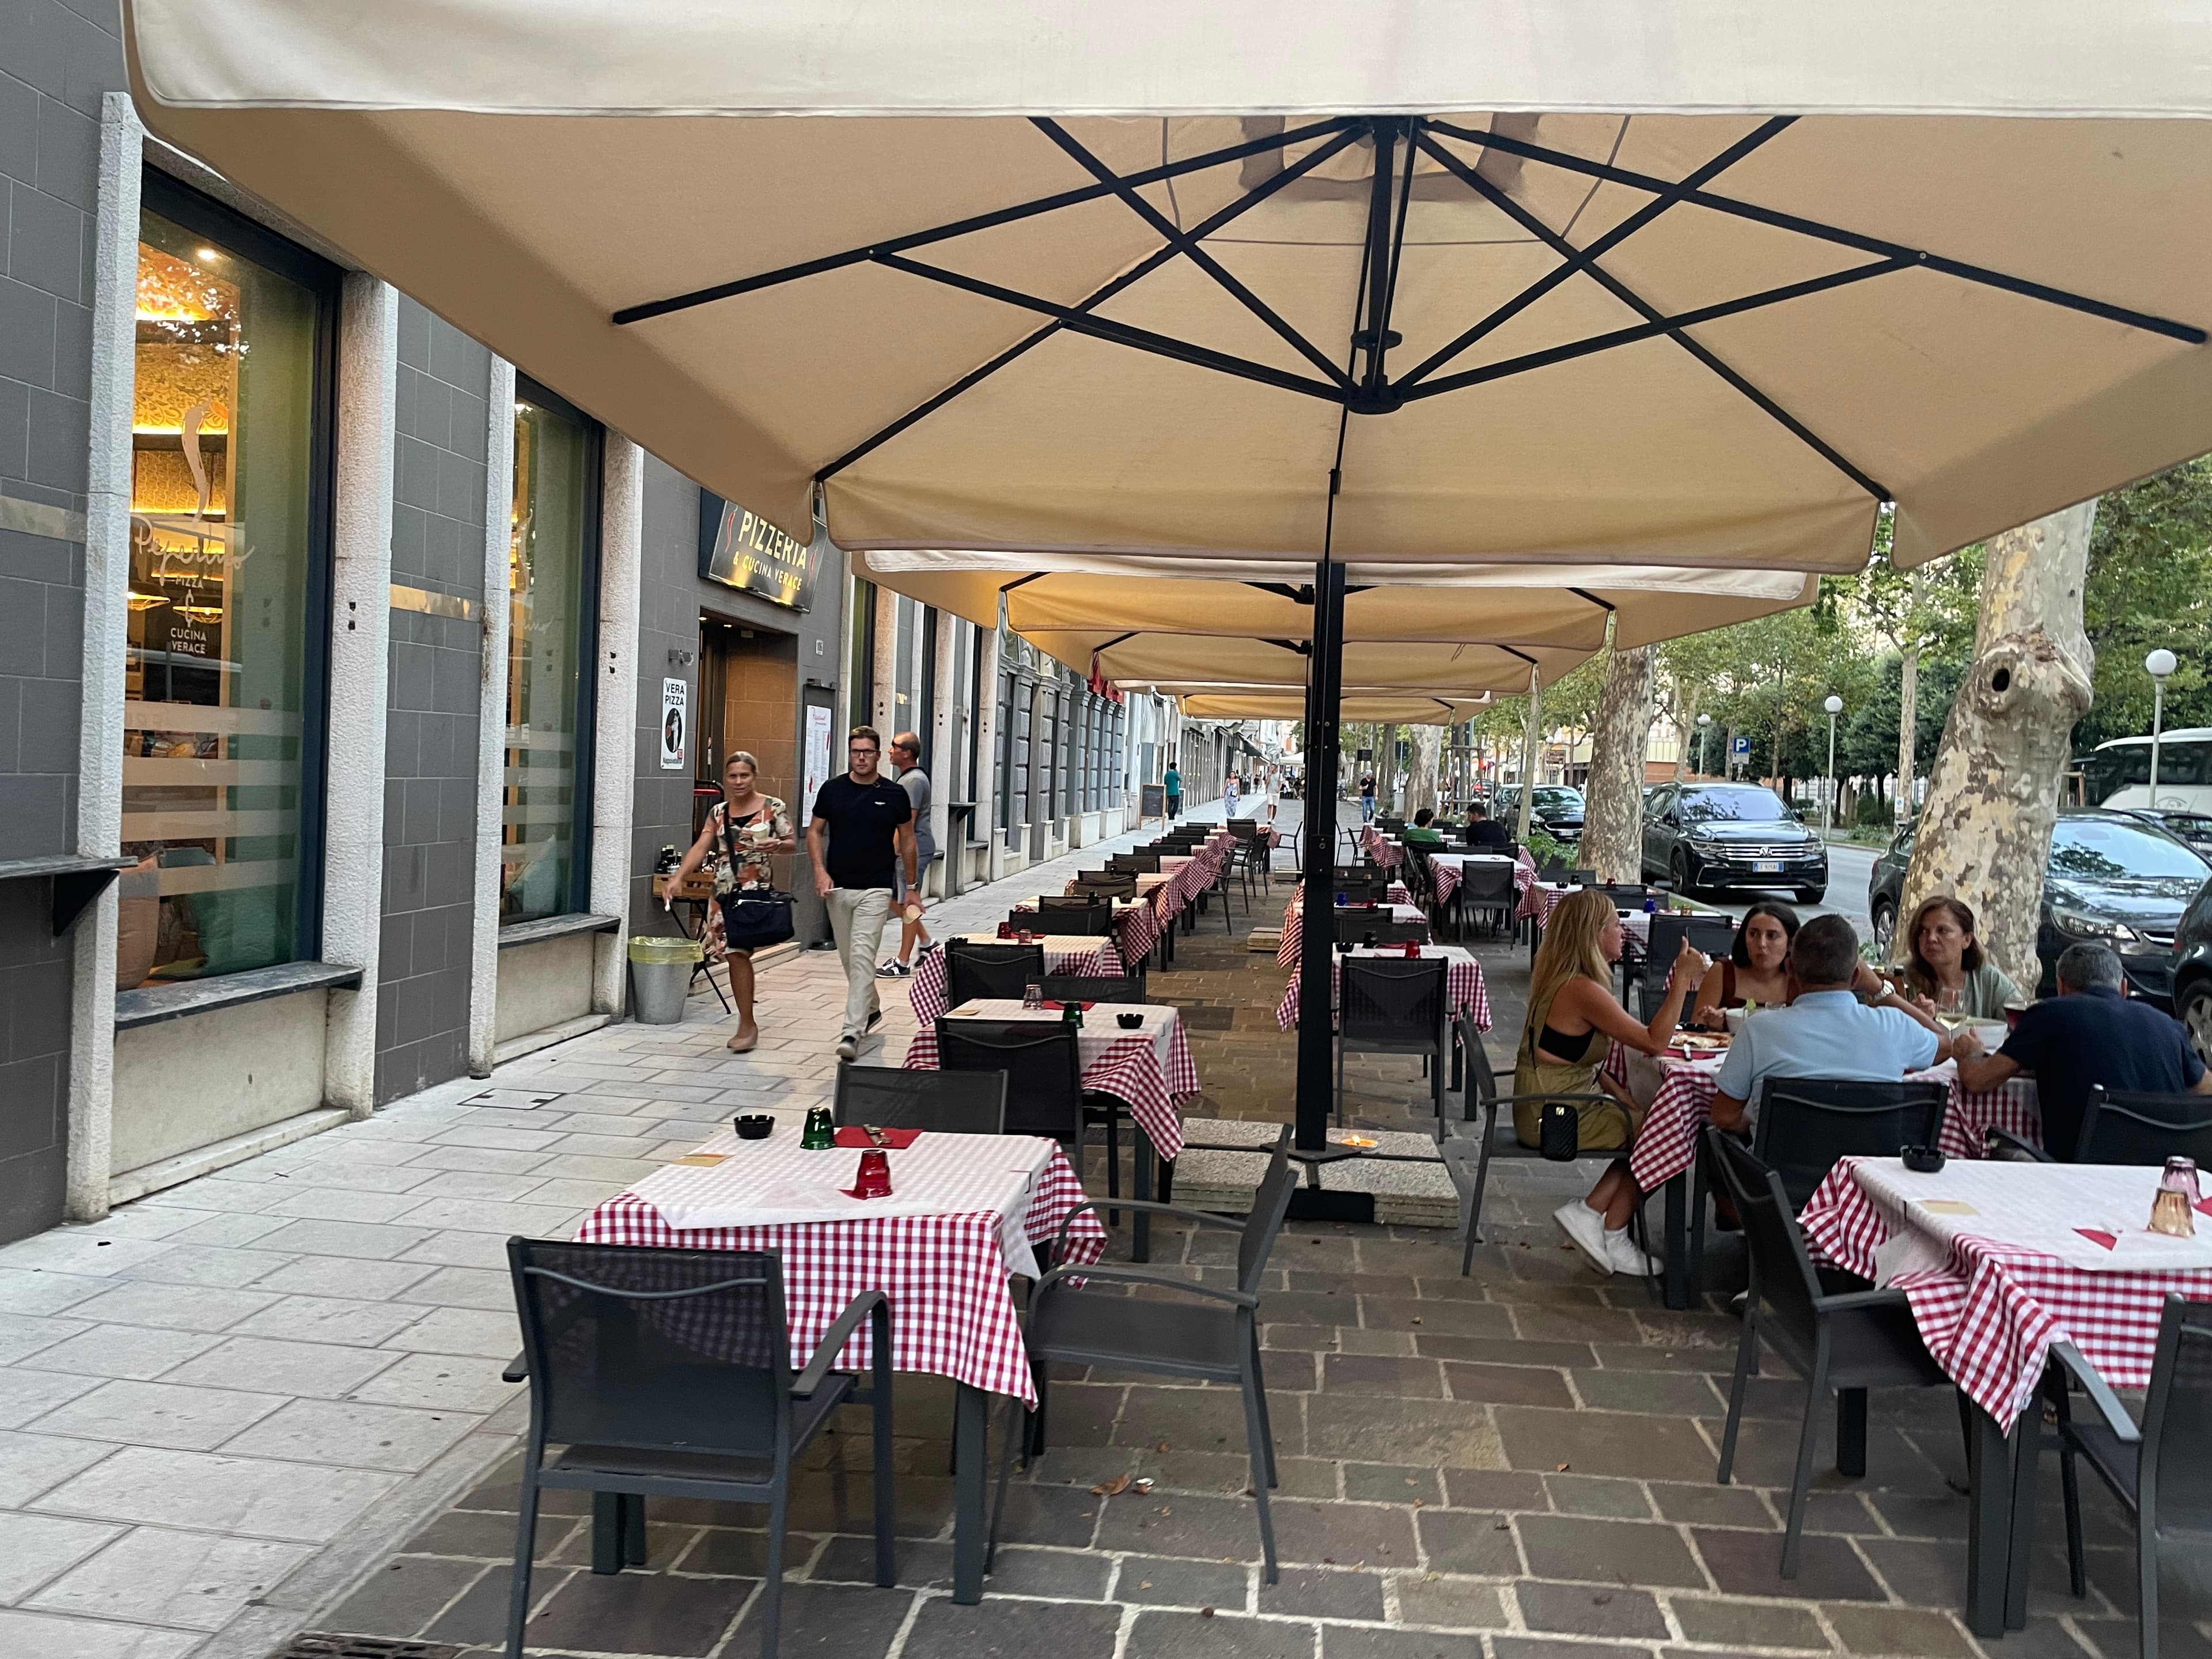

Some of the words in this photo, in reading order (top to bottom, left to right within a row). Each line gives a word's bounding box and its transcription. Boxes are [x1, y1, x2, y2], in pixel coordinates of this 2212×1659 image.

[738, 510, 807, 570] PIZZERIA
[733, 551, 739, 566] &
[742, 555, 772, 579] CUCINA
[775, 568, 802, 591] VERACE
[175, 576, 203, 589] PIZZA
[171, 627, 207, 641] CUCINA
[172, 640, 206, 654] VERACE
[665, 683, 684, 695] VERA
[665, 695, 684, 706] PIZZA
[1736, 738, 1747, 752] P
